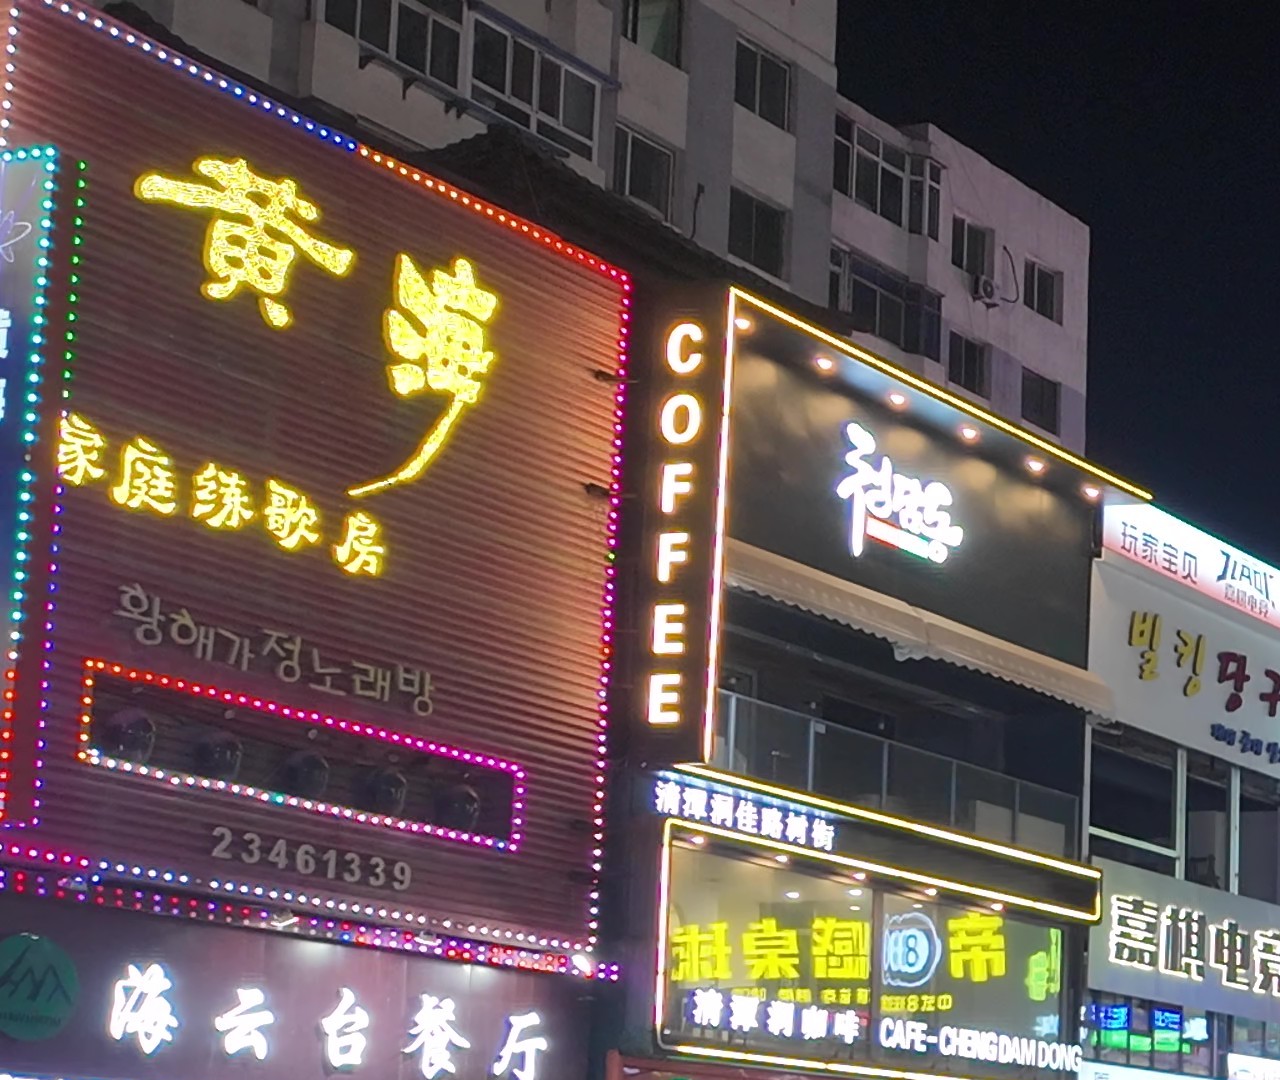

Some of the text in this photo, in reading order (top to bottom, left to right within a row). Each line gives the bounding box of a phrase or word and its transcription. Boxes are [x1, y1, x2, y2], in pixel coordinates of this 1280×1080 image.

[133, 157, 498, 497] 黄海
[57, 415, 384, 576] 家庭练歌房
[647, 321, 703, 725] COFFEE
[1121, 521, 1198, 585] 玩家宝贝
[211, 826, 412, 890] 23461339
